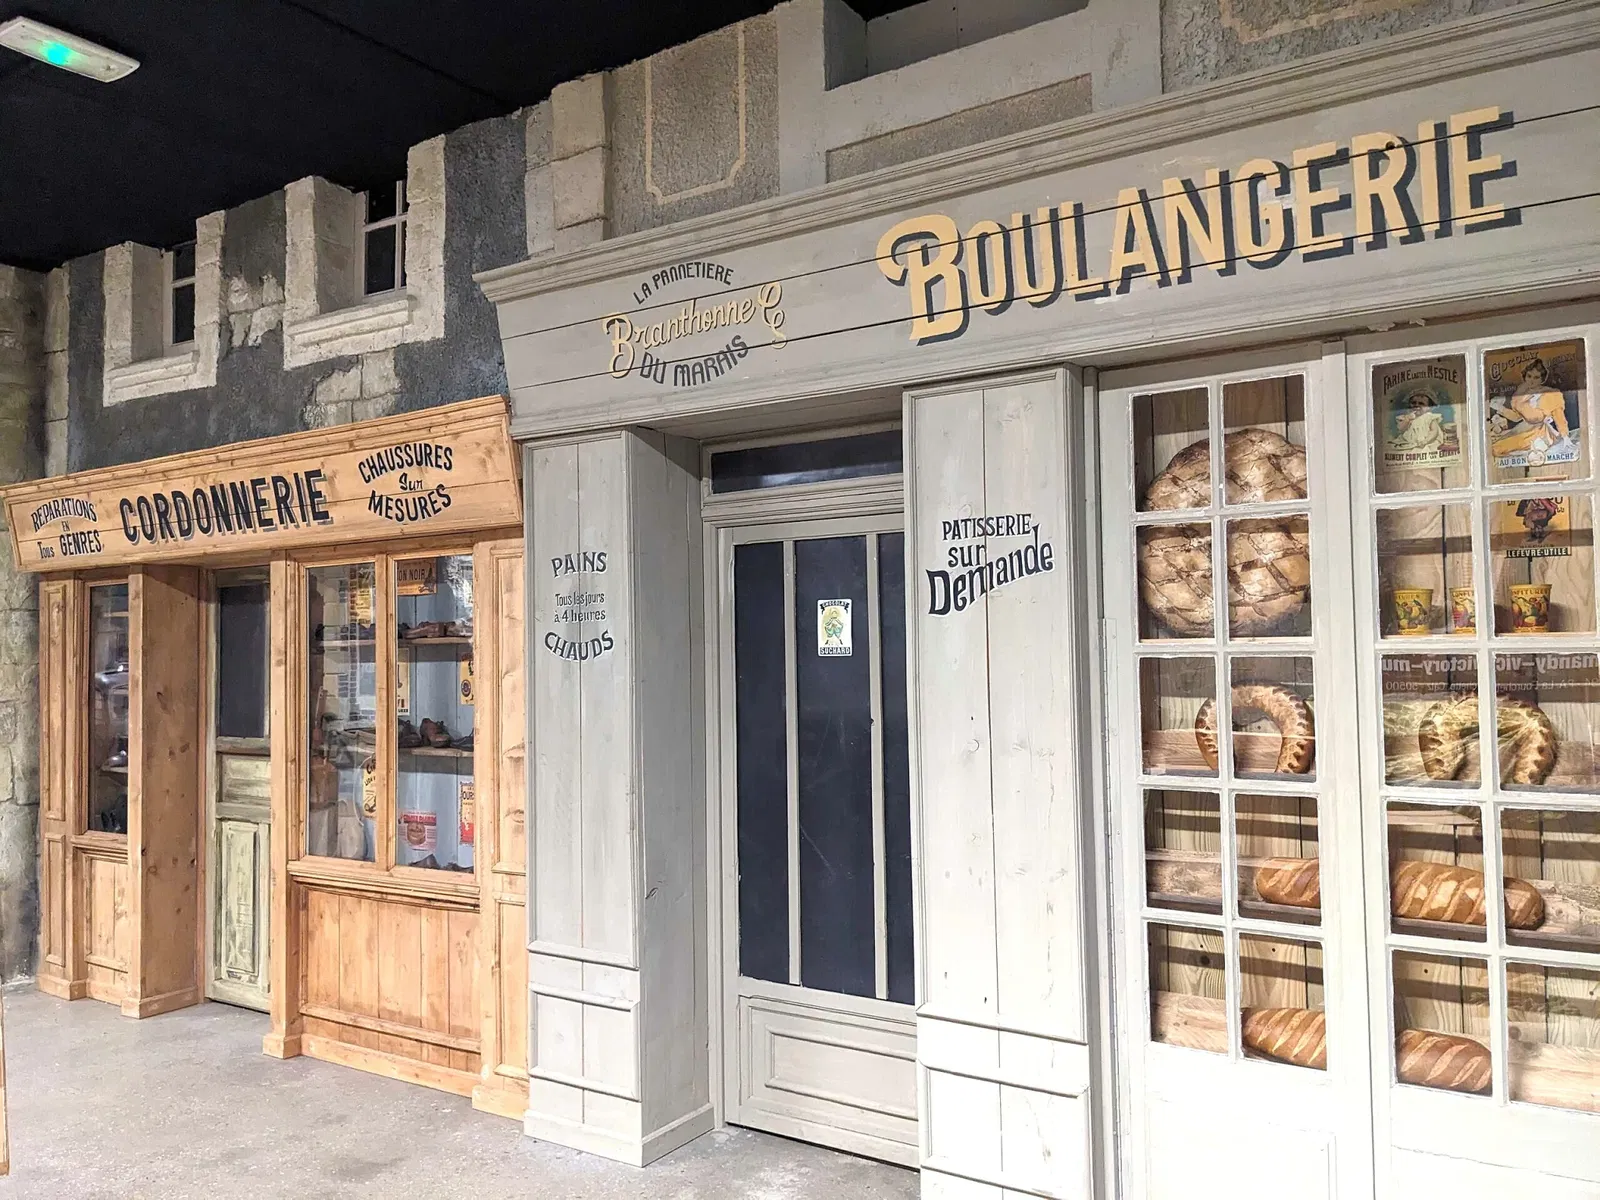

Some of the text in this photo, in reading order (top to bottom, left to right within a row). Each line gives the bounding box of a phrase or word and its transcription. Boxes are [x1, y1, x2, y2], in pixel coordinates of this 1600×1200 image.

[876, 106, 1522, 346] BOULANGERIE
[633, 261, 734, 304] LA PANNETIERE
[639, 334, 749, 386] DU MARAIS
[1384, 369, 1411, 395] FARINE
[358, 442, 453, 484] CHAUSSURES
[1511, 457, 1527, 465] BON
[399, 472, 423, 491] Sur
[31, 497, 98, 533] REPARATIONS
[119, 469, 333, 547] CORDONNERIE
[368, 483, 452, 522] MESURES
[62, 520, 71, 532] EN
[942, 513, 1032, 541] PATISSERIE
[37, 541, 55, 560] Tous
[947, 544, 986, 568] sur
[551, 552, 607, 578] PAINS
[925, 523, 1054, 616] Demande
[555, 591, 605, 607] Tous les jours
[554, 609, 606, 623] à 4 heures
[543, 629, 614, 661] CHAUDS
[820, 647, 851, 655] SUCHARD
